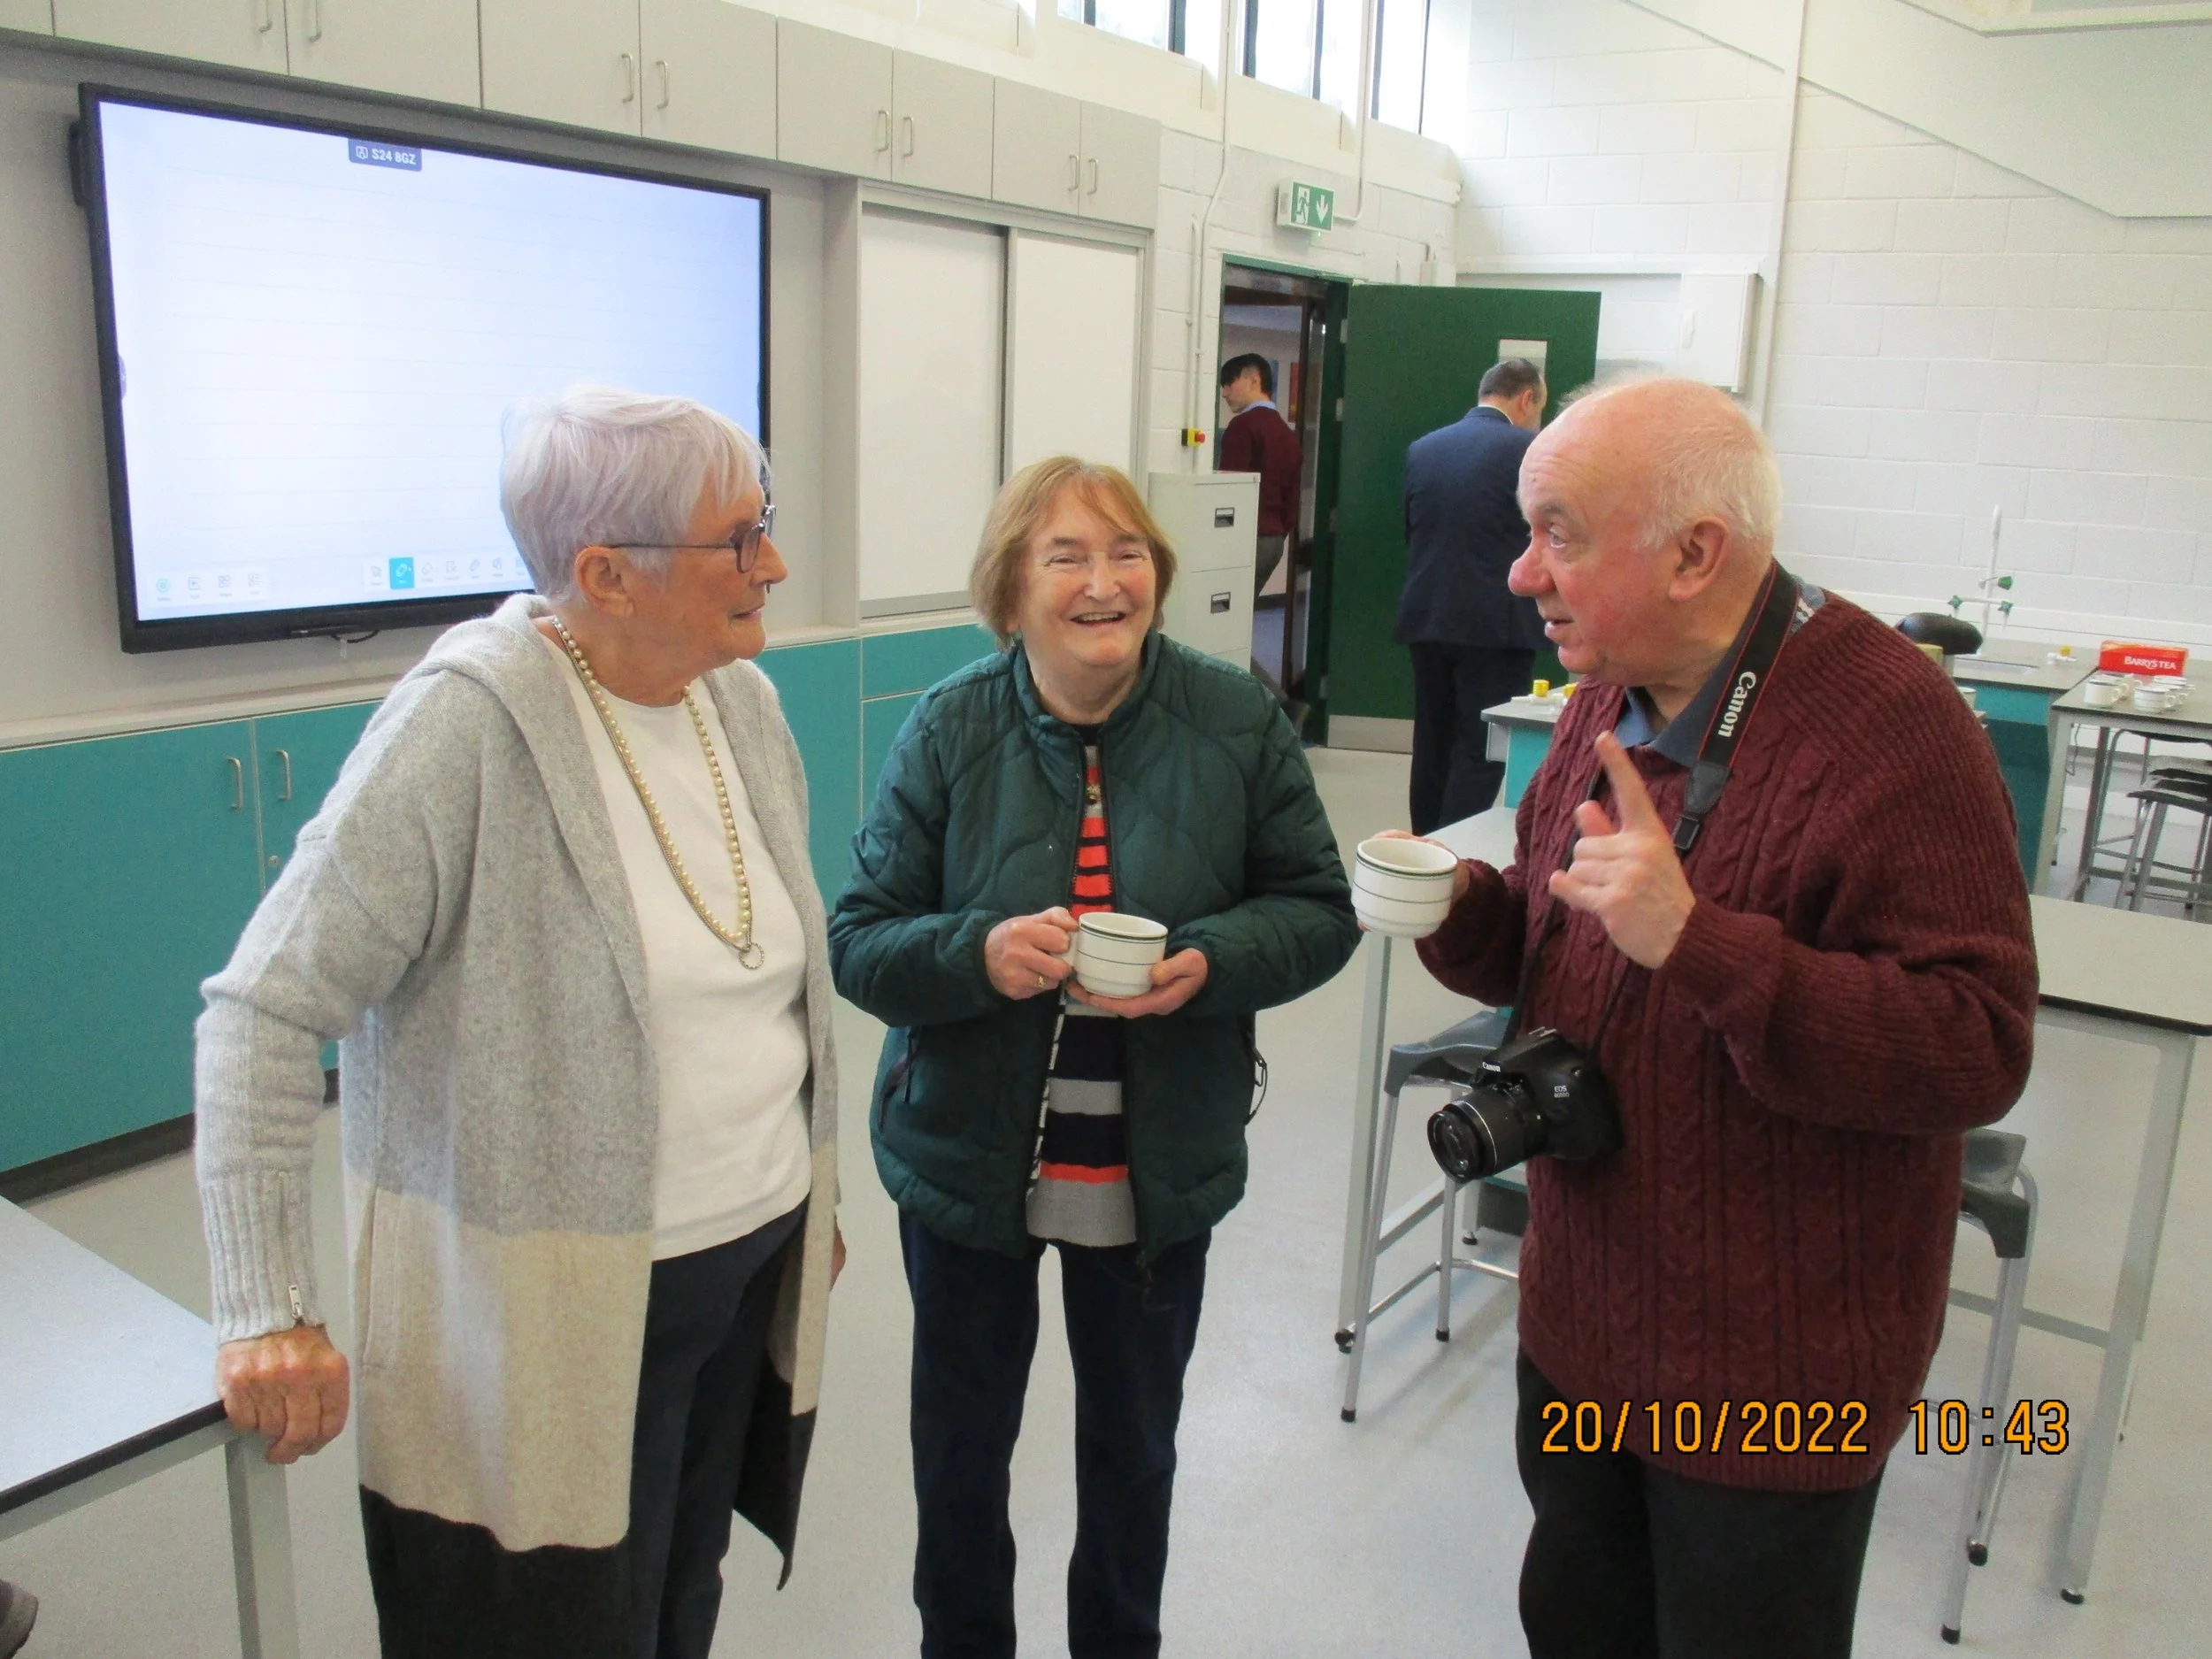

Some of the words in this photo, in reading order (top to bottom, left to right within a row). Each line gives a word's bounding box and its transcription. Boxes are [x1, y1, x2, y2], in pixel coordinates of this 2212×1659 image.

[372, 148, 393, 162] S24
[395, 151, 416, 165] 8GZ
[2159, 661, 2177, 670] TEA
[1717, 671, 1756, 737] Canon
[1482, 1061, 1502, 1072] Canon
